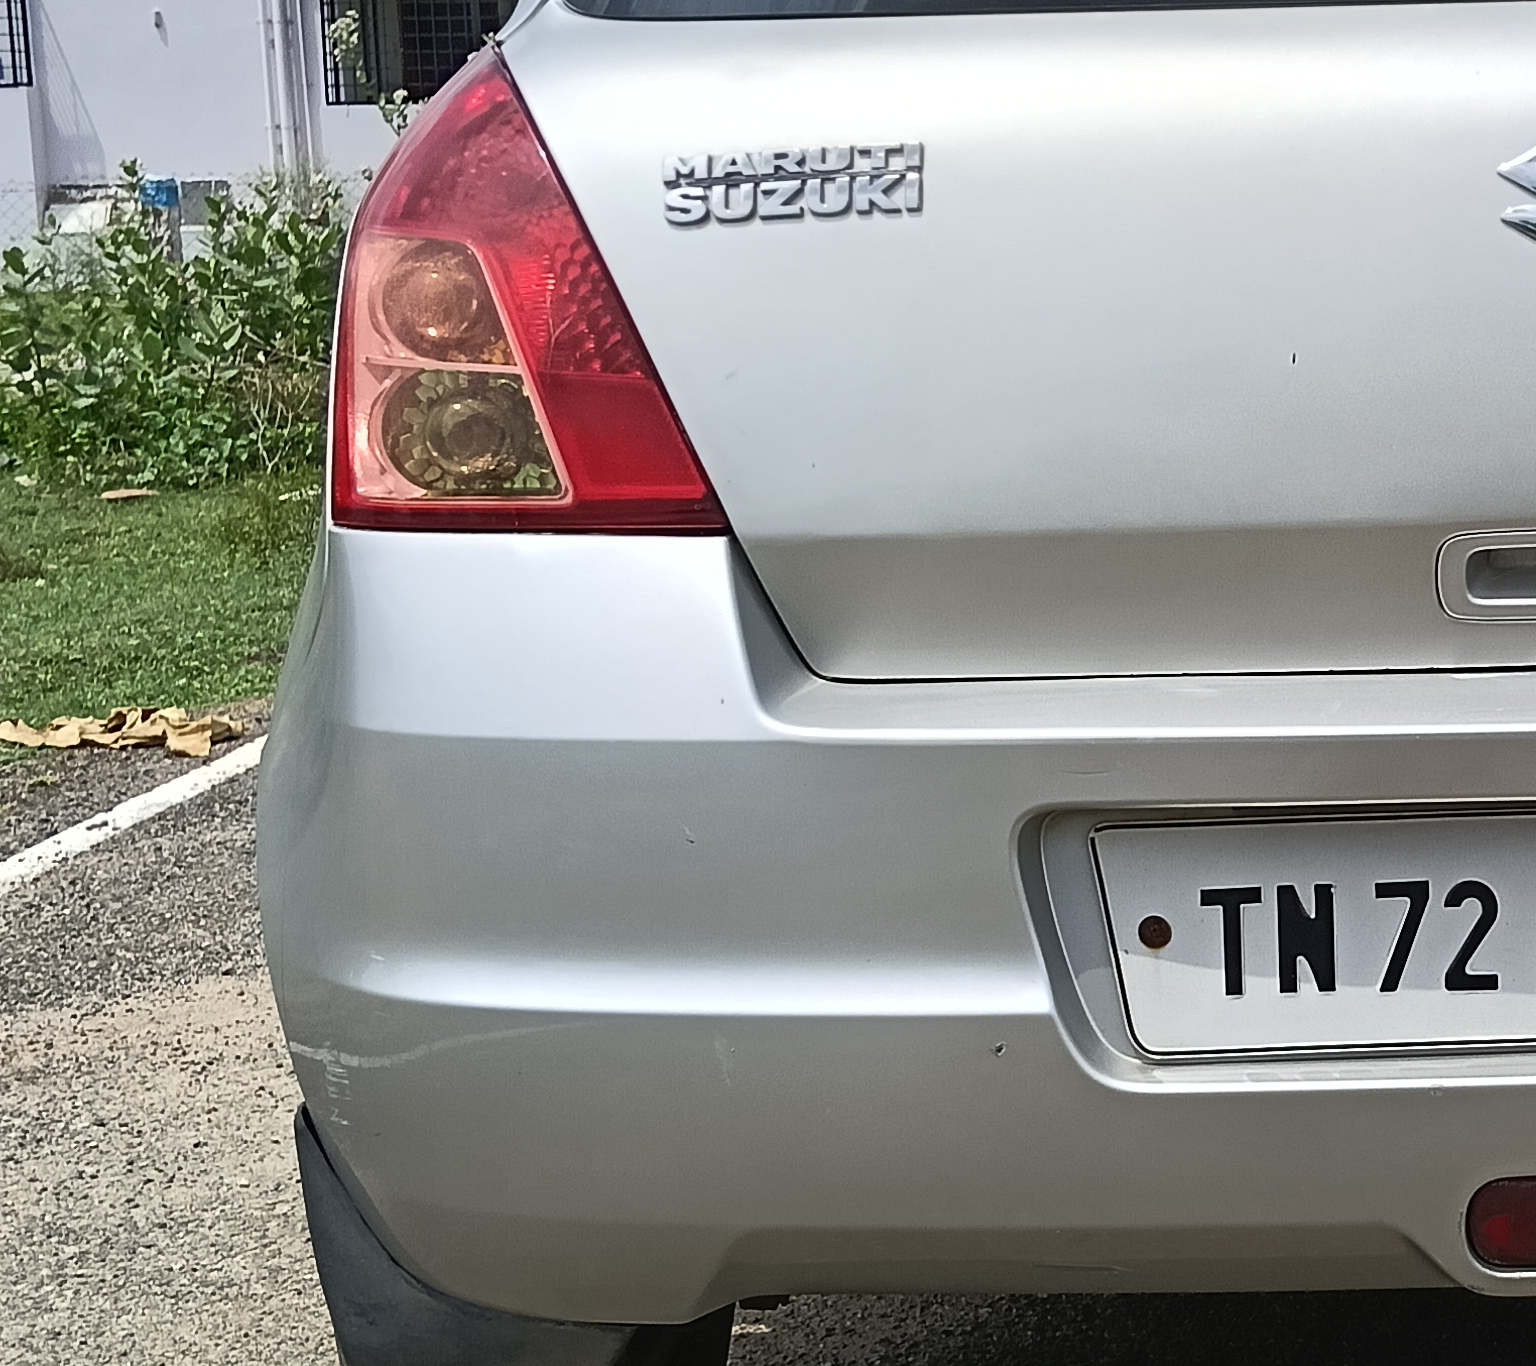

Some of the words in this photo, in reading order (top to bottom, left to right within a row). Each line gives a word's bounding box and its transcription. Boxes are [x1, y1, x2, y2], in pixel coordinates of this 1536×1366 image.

[662, 140, 924, 187] MARUTI
[662, 172, 924, 226] SUZUKI
[1199, 883, 1337, 997] TN
[1374, 879, 1499, 994] 72
